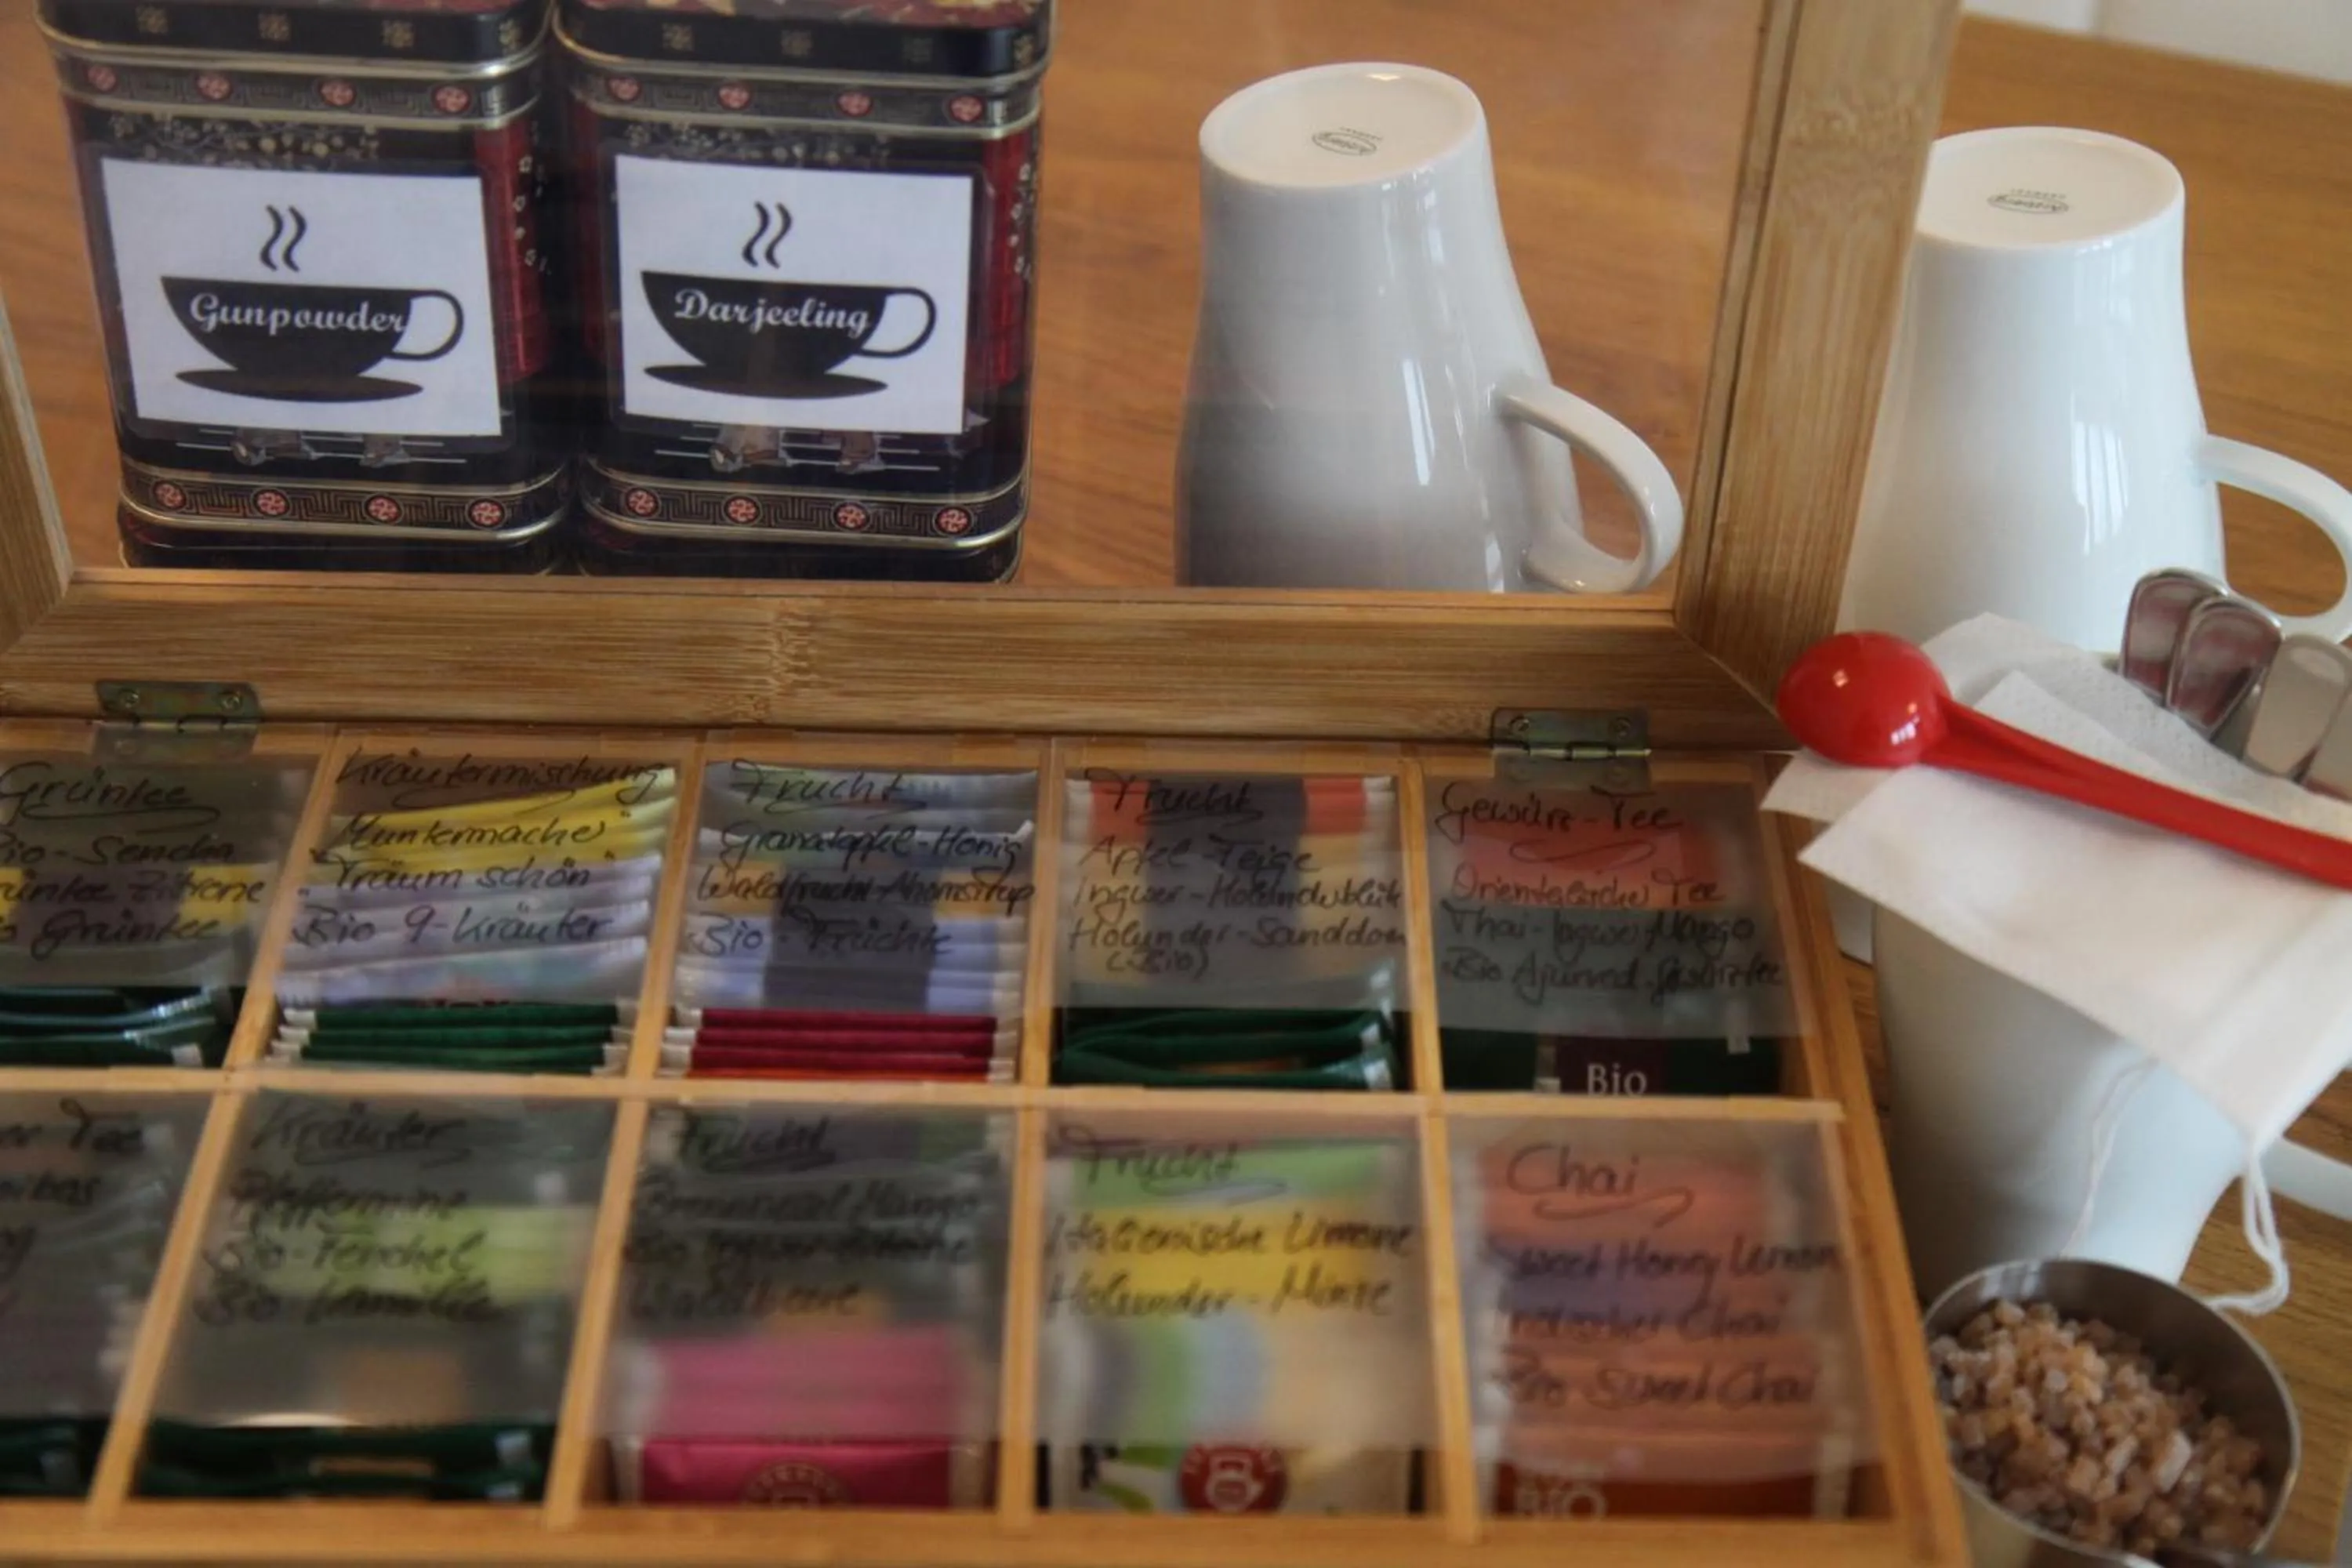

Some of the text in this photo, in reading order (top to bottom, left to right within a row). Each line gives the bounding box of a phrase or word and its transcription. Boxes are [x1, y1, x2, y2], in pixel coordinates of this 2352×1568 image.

[190, 292, 407, 336] Gunpowder
[674, 289, 871, 338] Darjeeling
[731, 759, 904, 804] Frucht
[1084, 768, 1255, 811] Frucht
[1651, 866, 1725, 903] Tee
[1587, 1063, 1647, 1096] Bio
[1506, 1142, 1639, 1196] Chai
